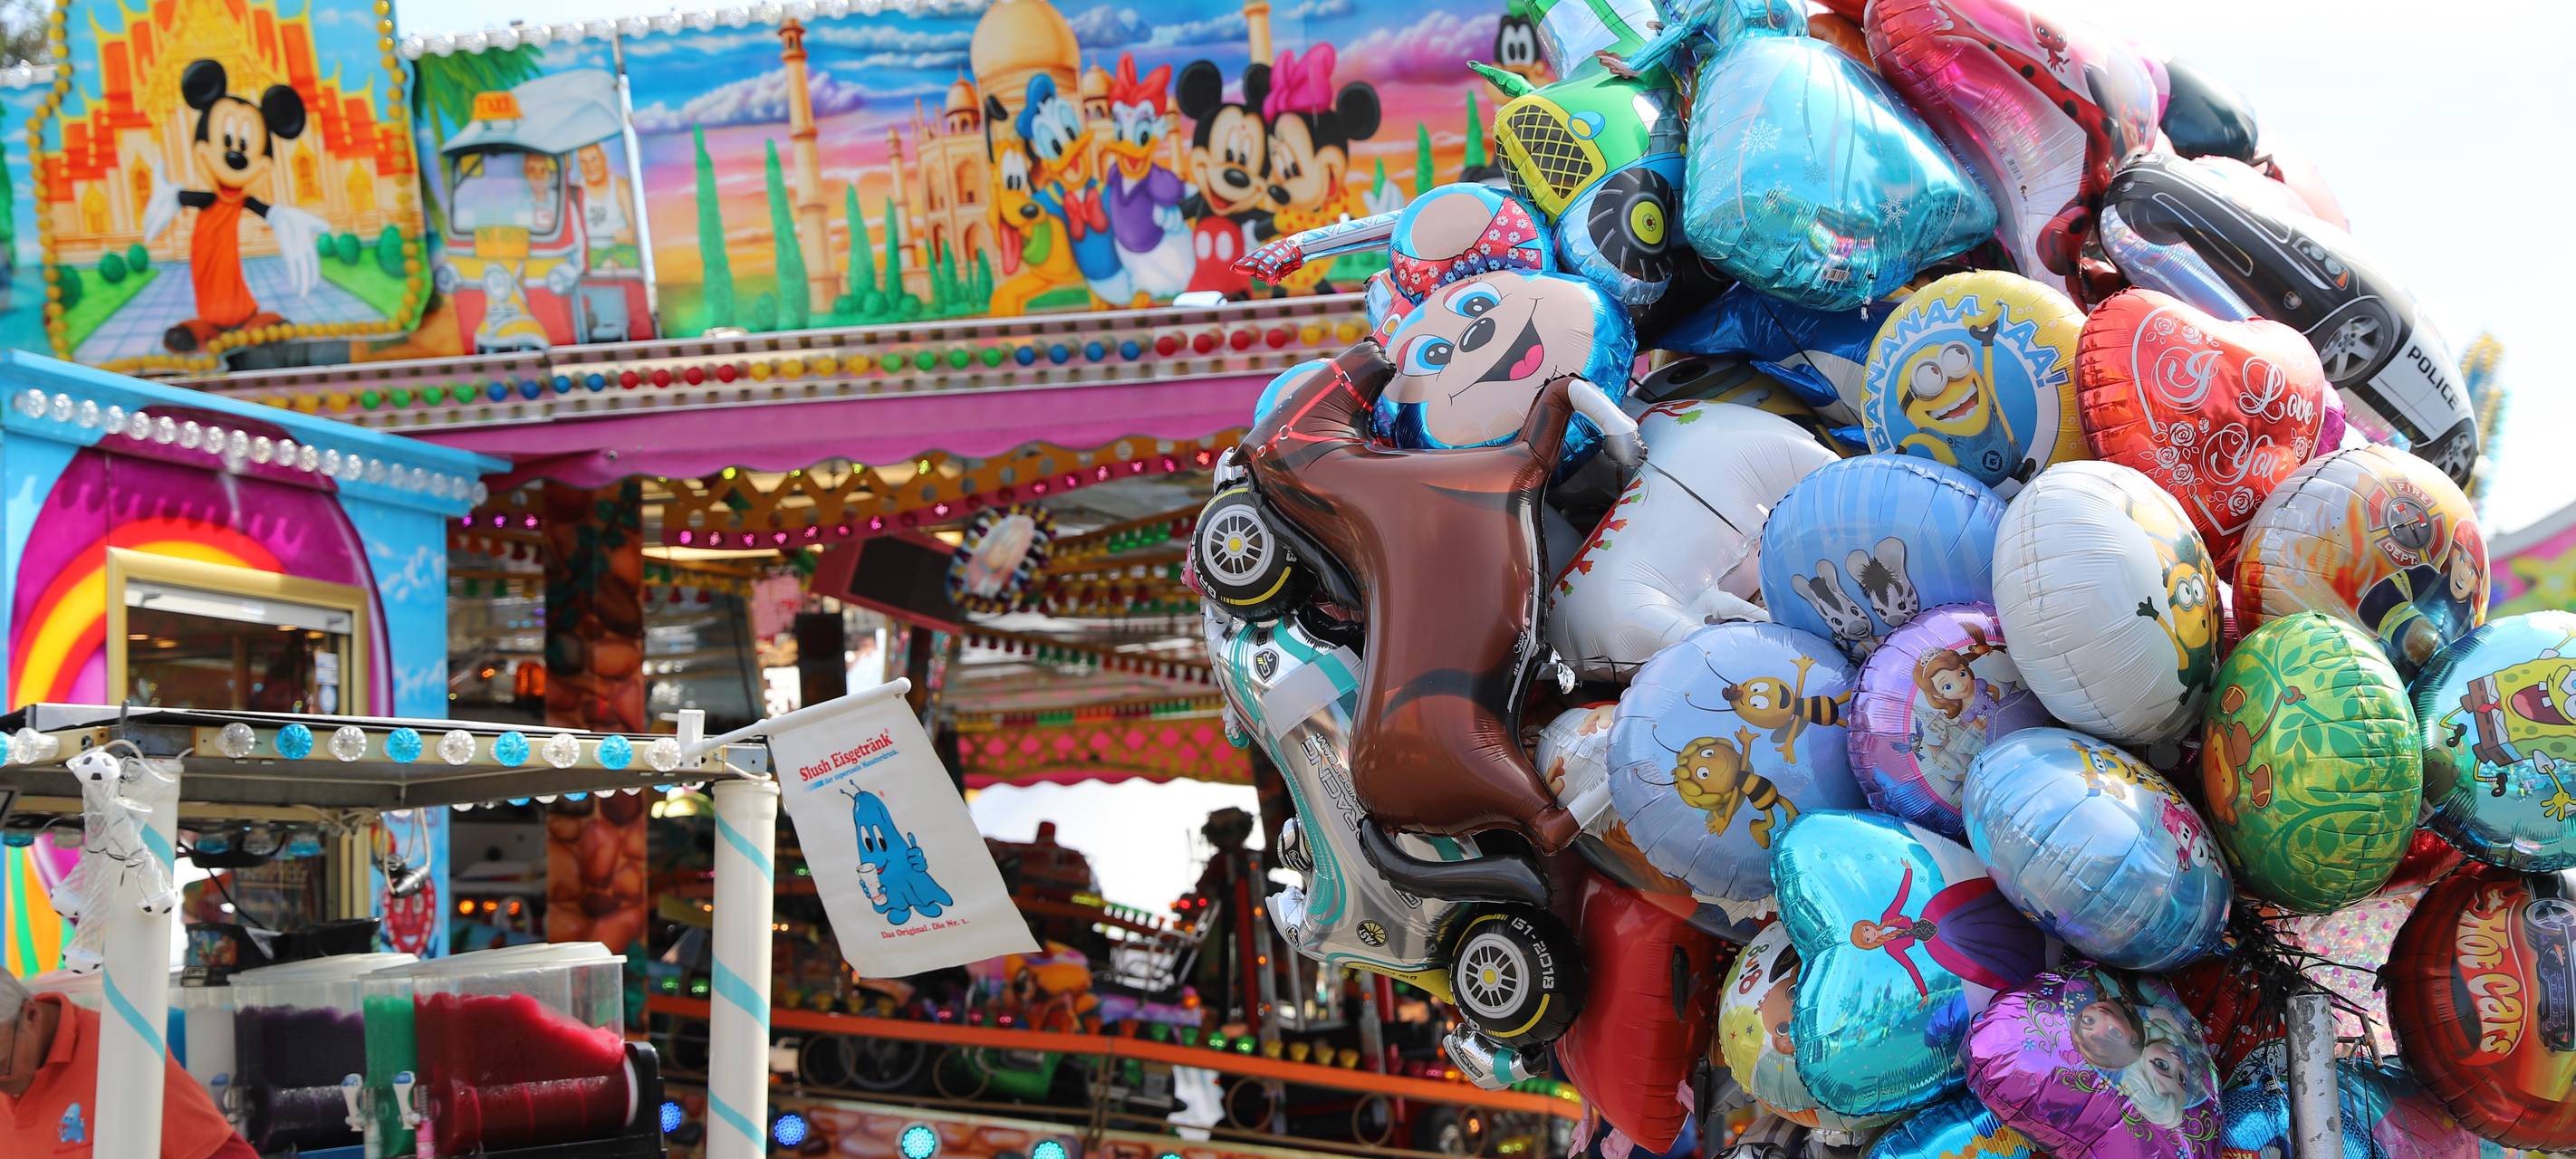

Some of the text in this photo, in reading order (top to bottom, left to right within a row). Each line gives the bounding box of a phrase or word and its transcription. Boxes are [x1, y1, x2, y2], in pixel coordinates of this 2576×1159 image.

[2233, 357, 2319, 426] Love
[2407, 345, 2460, 411] POLICE
[2199, 422, 2279, 489] You
[2396, 483, 2429, 504] FIRE
[2384, 541, 2417, 565] DEPT.
[799, 733, 893, 781] Slush Eisgetränk
[1300, 738, 1360, 831] RACING
[880, 931, 895, 939] Das
[932, 922, 946, 930] Die
[1359, 928, 1377, 945] FAST
